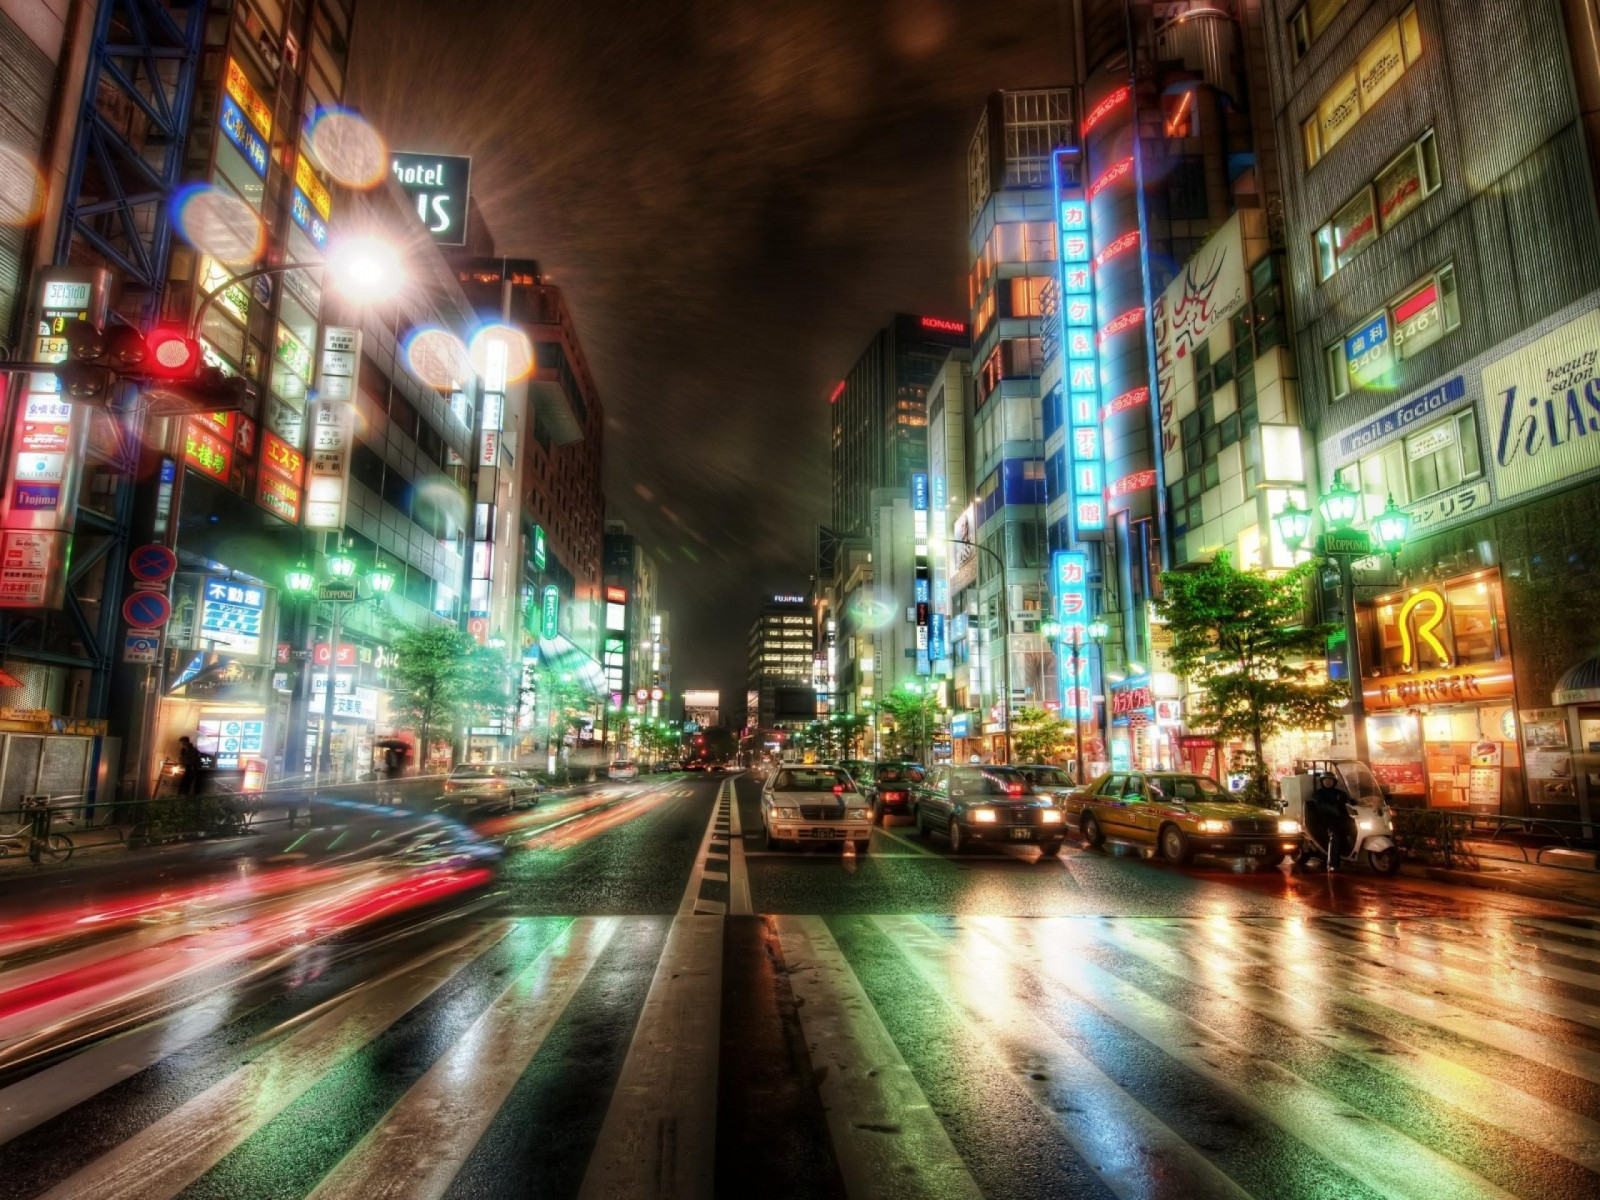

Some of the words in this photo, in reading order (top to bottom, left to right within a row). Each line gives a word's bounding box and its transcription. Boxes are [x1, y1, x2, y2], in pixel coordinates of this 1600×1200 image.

[311, 219, 326, 243] 6F
[922, 317, 964, 332] KONAMI
[1351, 323, 1384, 355] 歯科
[1392, 306, 1439, 347] 8461
[1546, 348, 1599, 382] beauty
[1550, 367, 1594, 396] salon
[1351, 421, 1382, 451] nail
[1384, 419, 1395, 433] &
[1397, 386, 1448, 427] facial
[266, 438, 301, 472] エステ
[1439, 488, 1477, 518] リラ
[1327, 535, 1369, 551] ROPPONGI
[209, 582, 261, 606] 不動産
[319, 587, 354, 599] ROPPONGI
[774, 595, 804, 603] FUJIFILM
[546, 595, 555, 636] モスバーガー
[1399, 590, 1449, 666] R
[1062, 562, 1091, 709] カラオケ館
[316, 680, 347, 688] DRGS
[1396, 674, 1482, 706] BURGER
